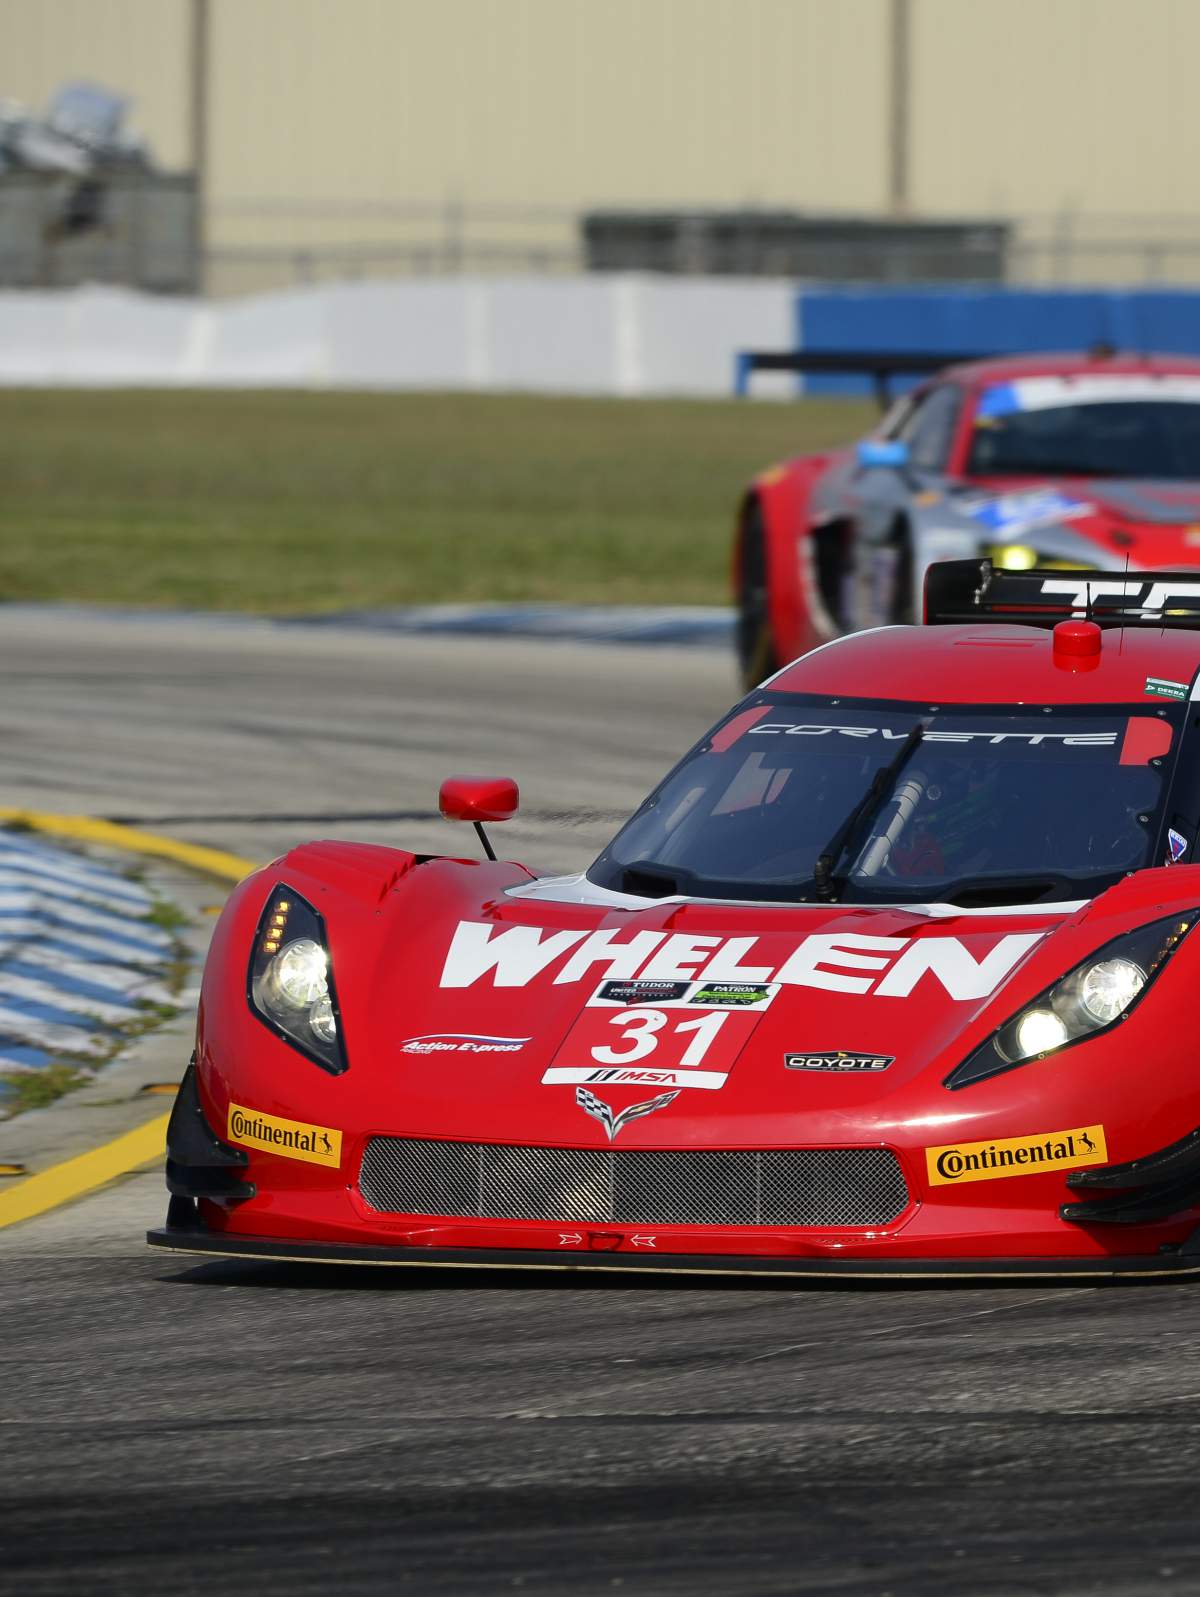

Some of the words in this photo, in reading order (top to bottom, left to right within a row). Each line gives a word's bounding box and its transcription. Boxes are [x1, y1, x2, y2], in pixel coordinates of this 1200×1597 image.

[748, 723, 1118, 745] CORVETTE
[439, 920, 1047, 1001] WHELEN
[632, 981, 676, 990] TUDOR
[403, 1041, 457, 1051] Action
[591, 1009, 730, 1067] 31
[789, 1057, 887, 1068] COYOTE
[615, 1071, 678, 1084] IMSA
[231, 1110, 316, 1153] Continental
[936, 1135, 1077, 1179] Continental
